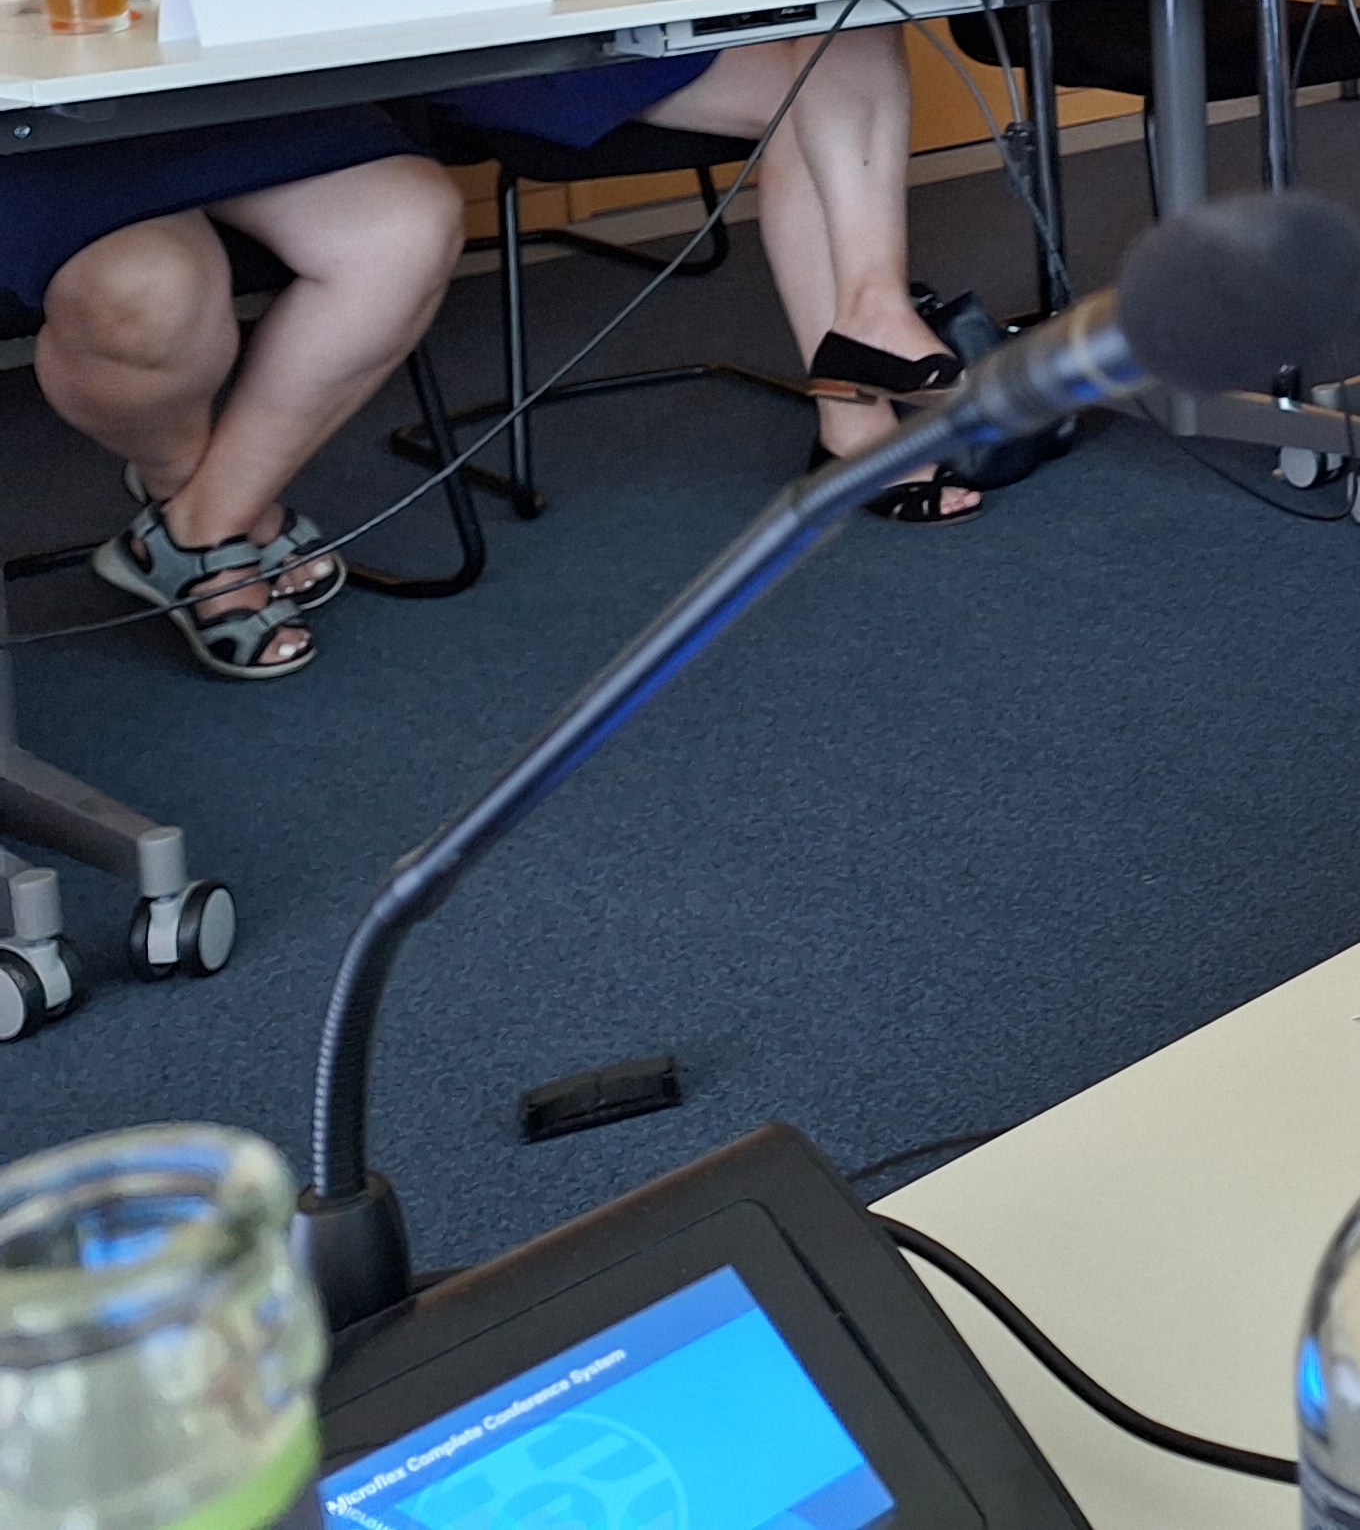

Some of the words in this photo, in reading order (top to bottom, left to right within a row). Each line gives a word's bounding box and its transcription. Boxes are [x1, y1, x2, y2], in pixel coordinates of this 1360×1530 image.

[325, 1466, 408, 1515] Microflex
[406, 1425, 483, 1473] Complete
[482, 1379, 571, 1431] Conference
[569, 1348, 626, 1384] System
